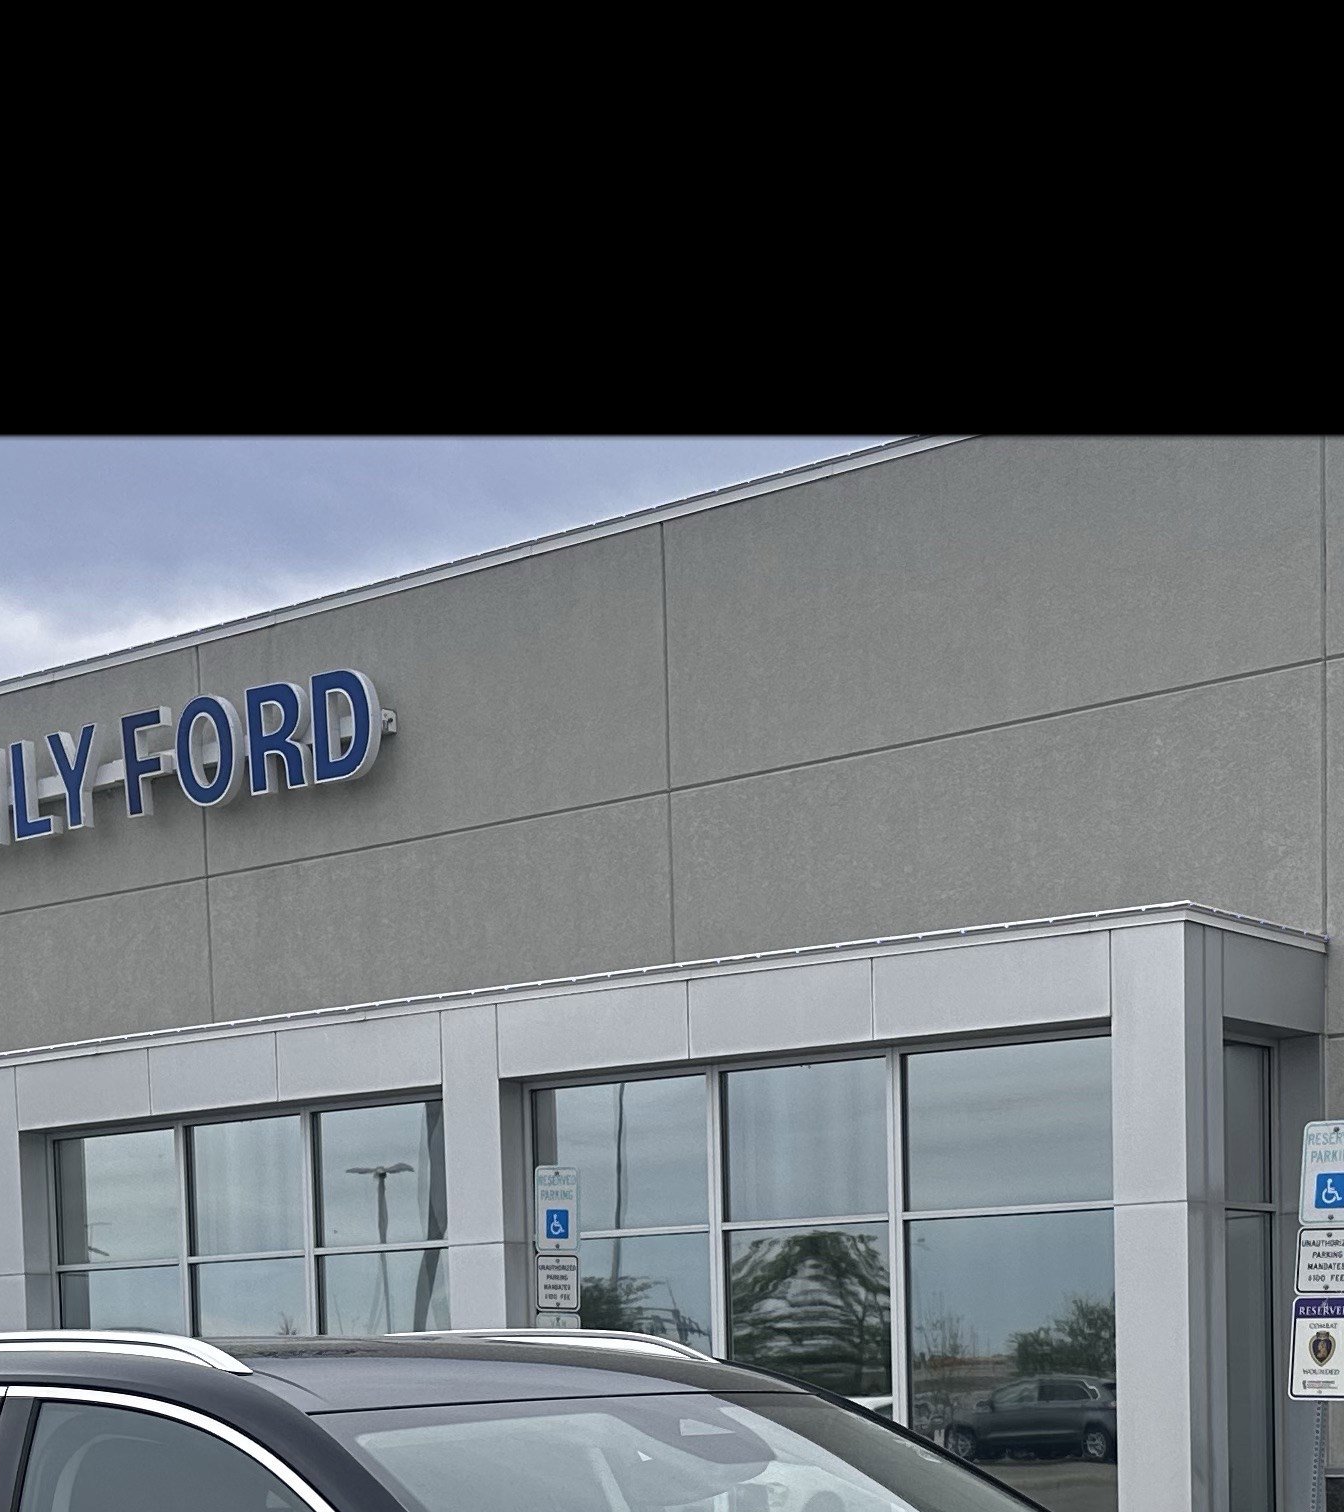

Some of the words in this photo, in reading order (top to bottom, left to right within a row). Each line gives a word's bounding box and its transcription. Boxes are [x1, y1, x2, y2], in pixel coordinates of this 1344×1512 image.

[120, 668, 381, 817] FORD
[540, 1189, 573, 1201] PARKING
[1312, 1250, 1343, 1259] PARKING
[1330, 1274, 1344, 1282] FEE
